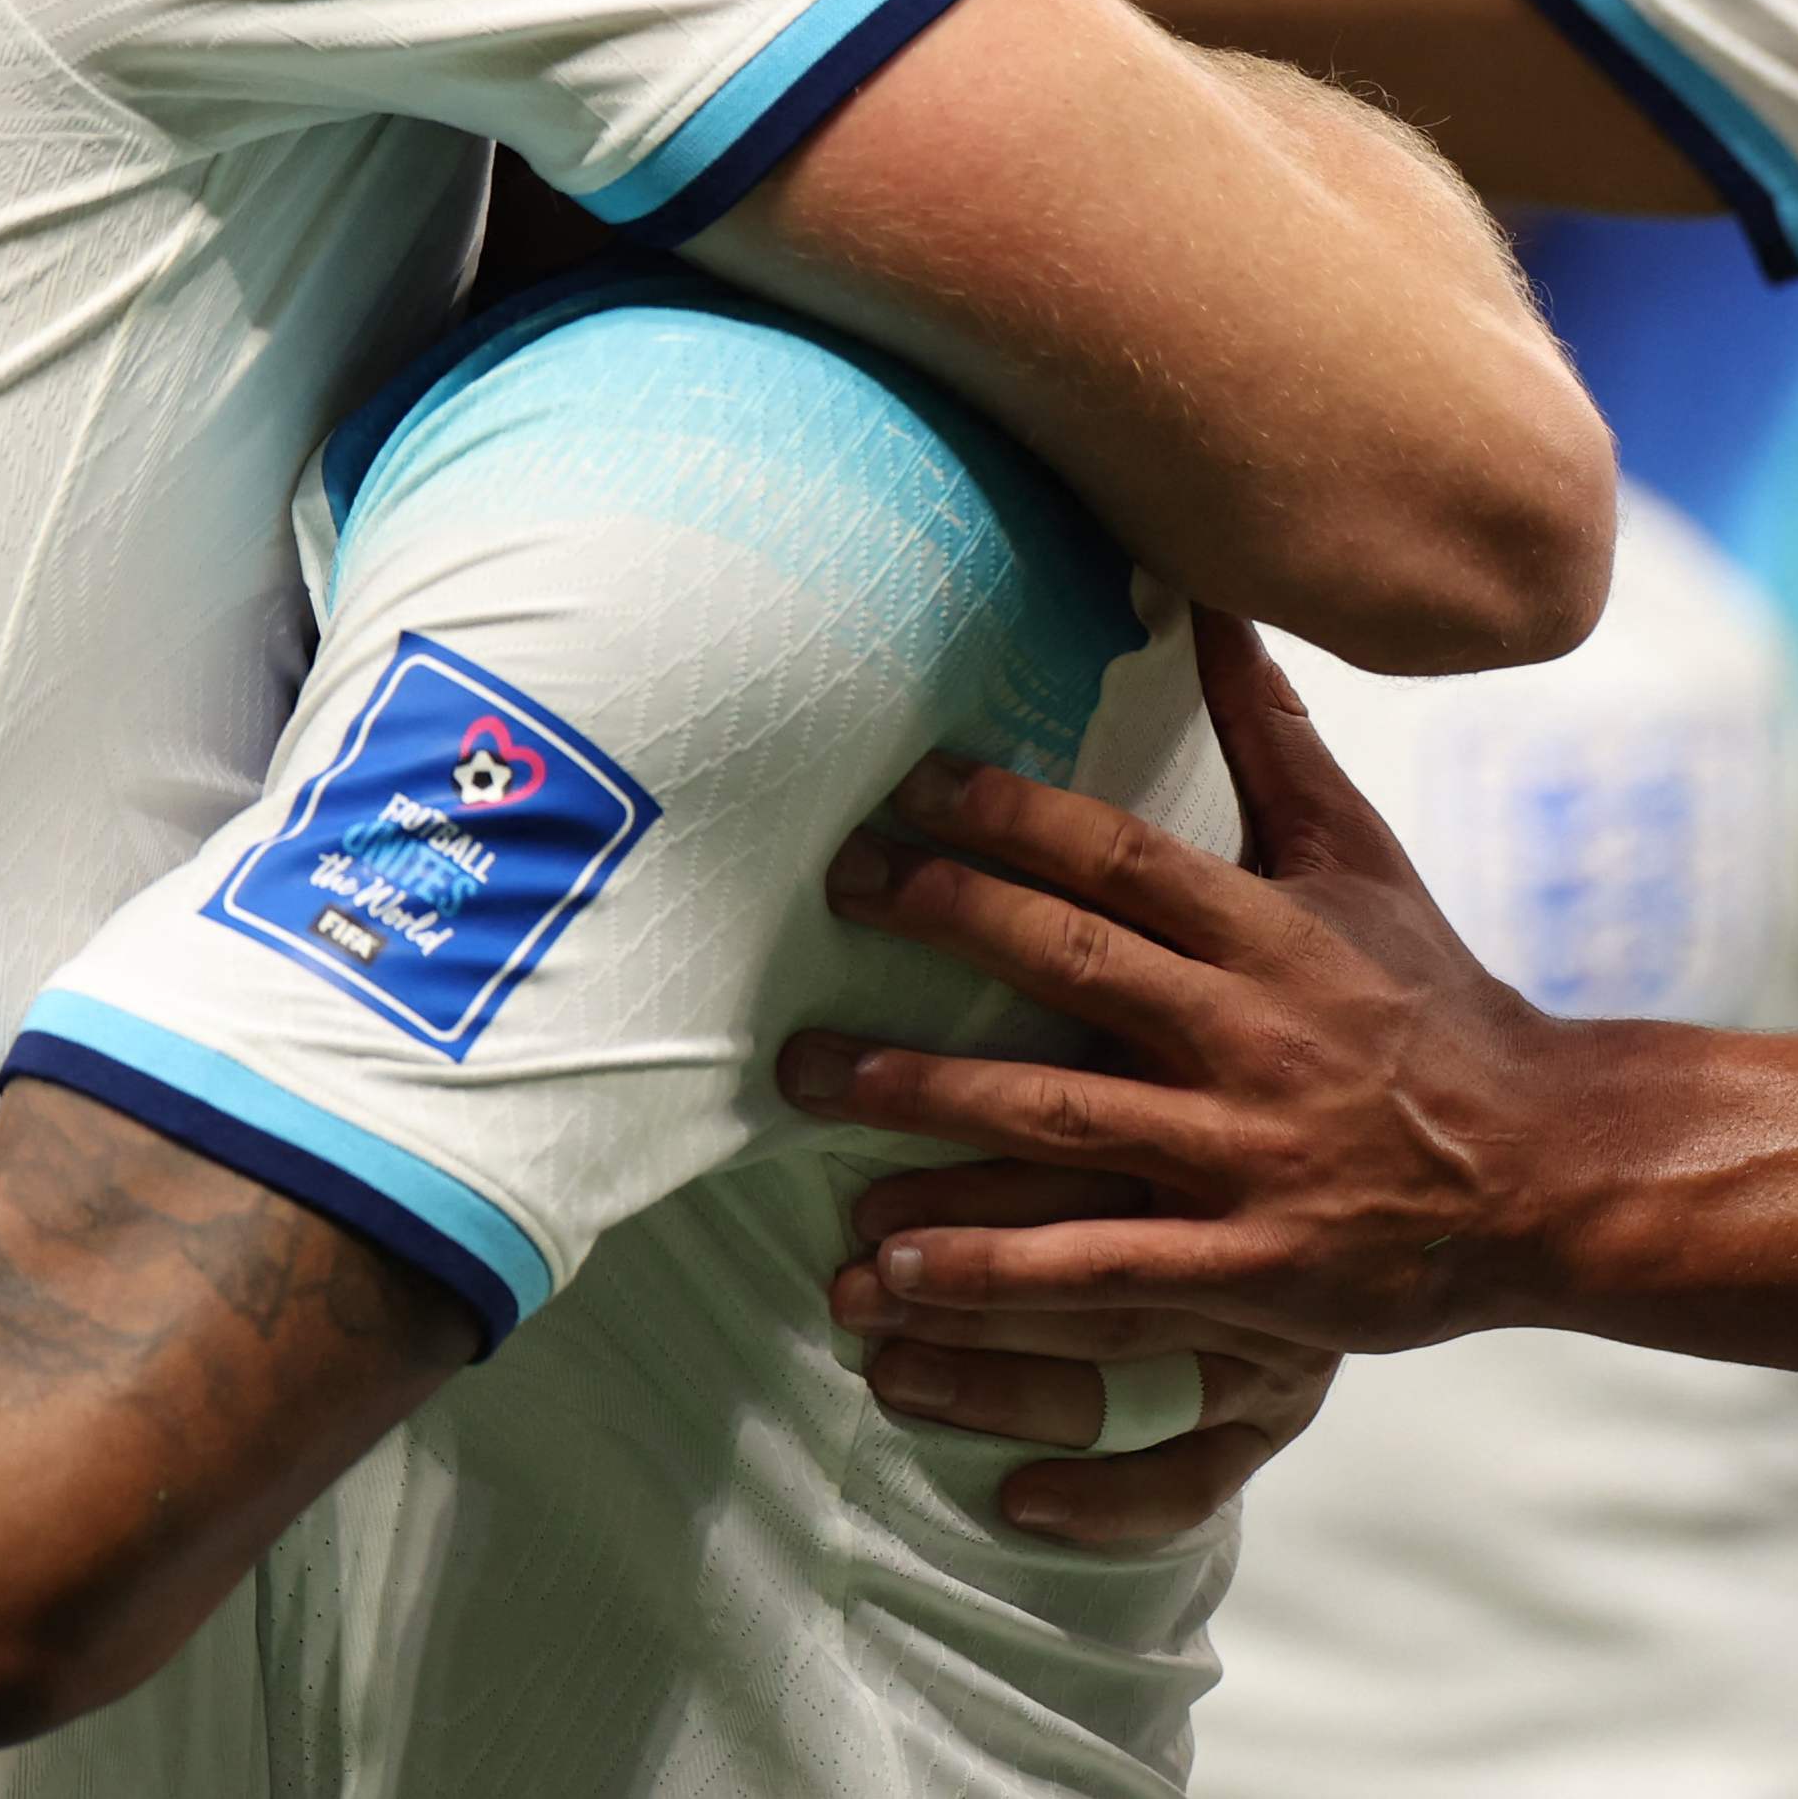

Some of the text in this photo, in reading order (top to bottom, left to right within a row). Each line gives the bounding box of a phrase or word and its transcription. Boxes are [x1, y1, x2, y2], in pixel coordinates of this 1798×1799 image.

[310, 853, 455, 957] the World
[318, 909, 382, 960] FIFA
